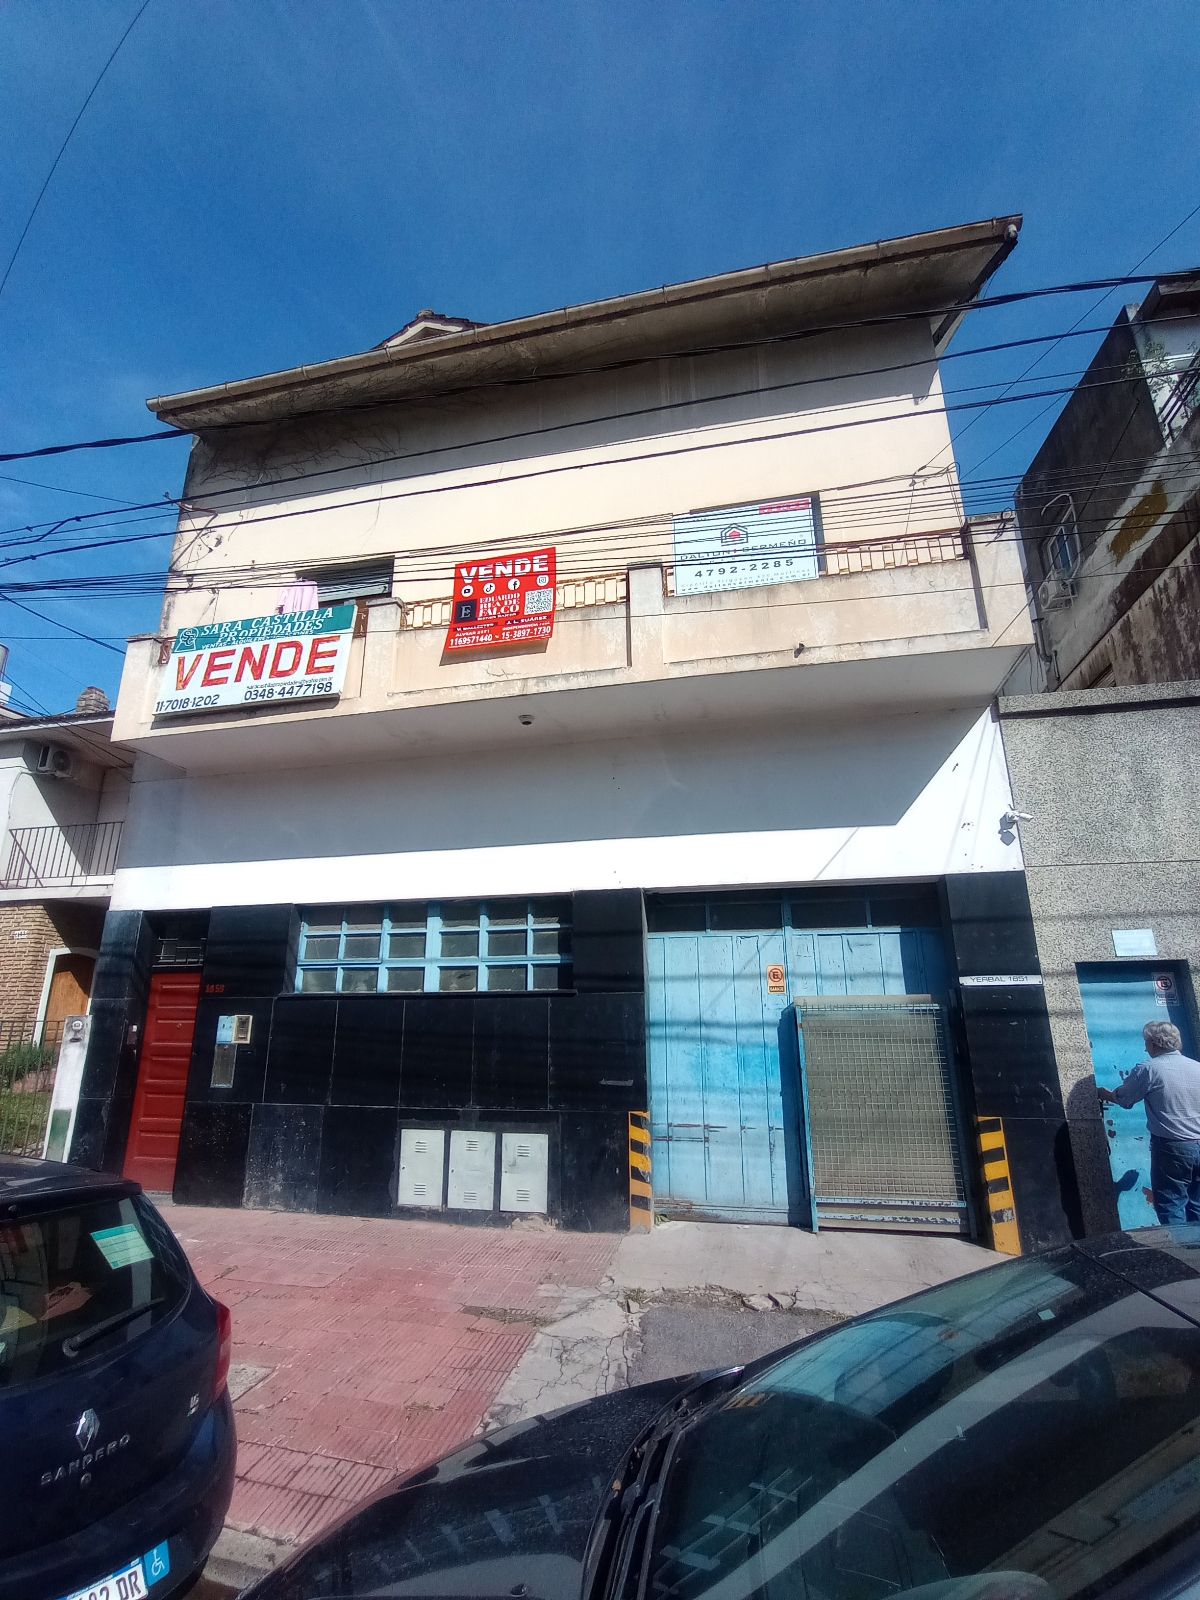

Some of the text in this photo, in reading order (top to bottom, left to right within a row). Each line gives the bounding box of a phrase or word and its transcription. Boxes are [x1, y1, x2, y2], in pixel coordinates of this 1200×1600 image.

[460, 554, 548, 583] VENDE
[695, 559, 793, 577] 4792-2285
[201, 608, 334, 636] SARA CASTILLA
[479, 604, 520, 618] FALCO
[217, 619, 324, 643] PROPIEDADES
[175, 635, 341, 691] VENDE
[41, 1434, 131, 1486] SANDERO
